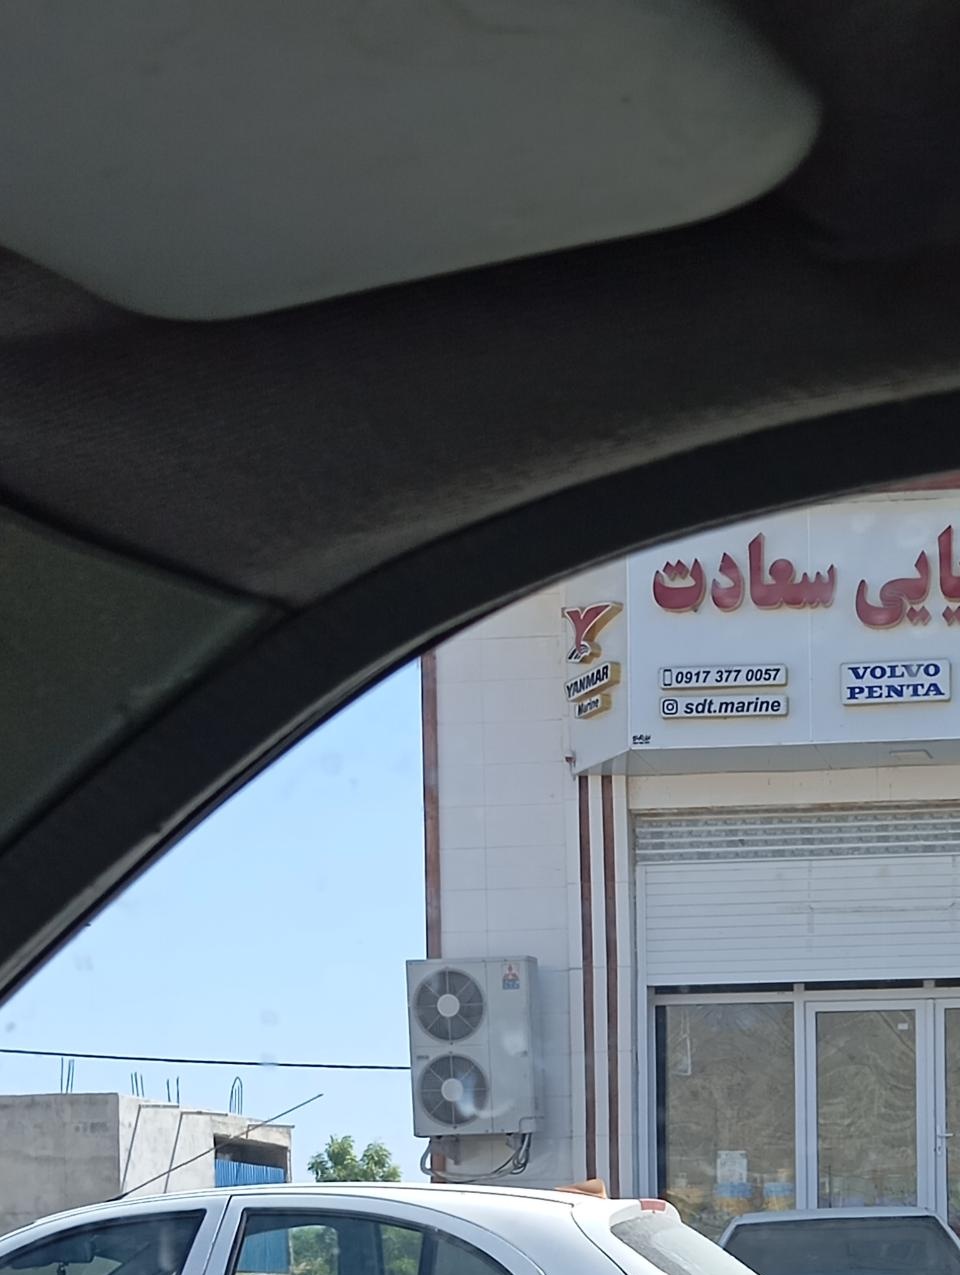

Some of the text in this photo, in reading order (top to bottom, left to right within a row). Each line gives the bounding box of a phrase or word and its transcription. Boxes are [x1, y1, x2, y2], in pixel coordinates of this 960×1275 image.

[652, 532, 838, 613] سعادت
[675, 668, 781, 684] 0917 377 0057
[847, 663, 941, 680] VOLVO
[566, 664, 610, 699] YANMAR
[846, 682, 945, 700] PENTA
[577, 698, 600, 716] Marine
[683, 697, 781, 715] sdt.marine
